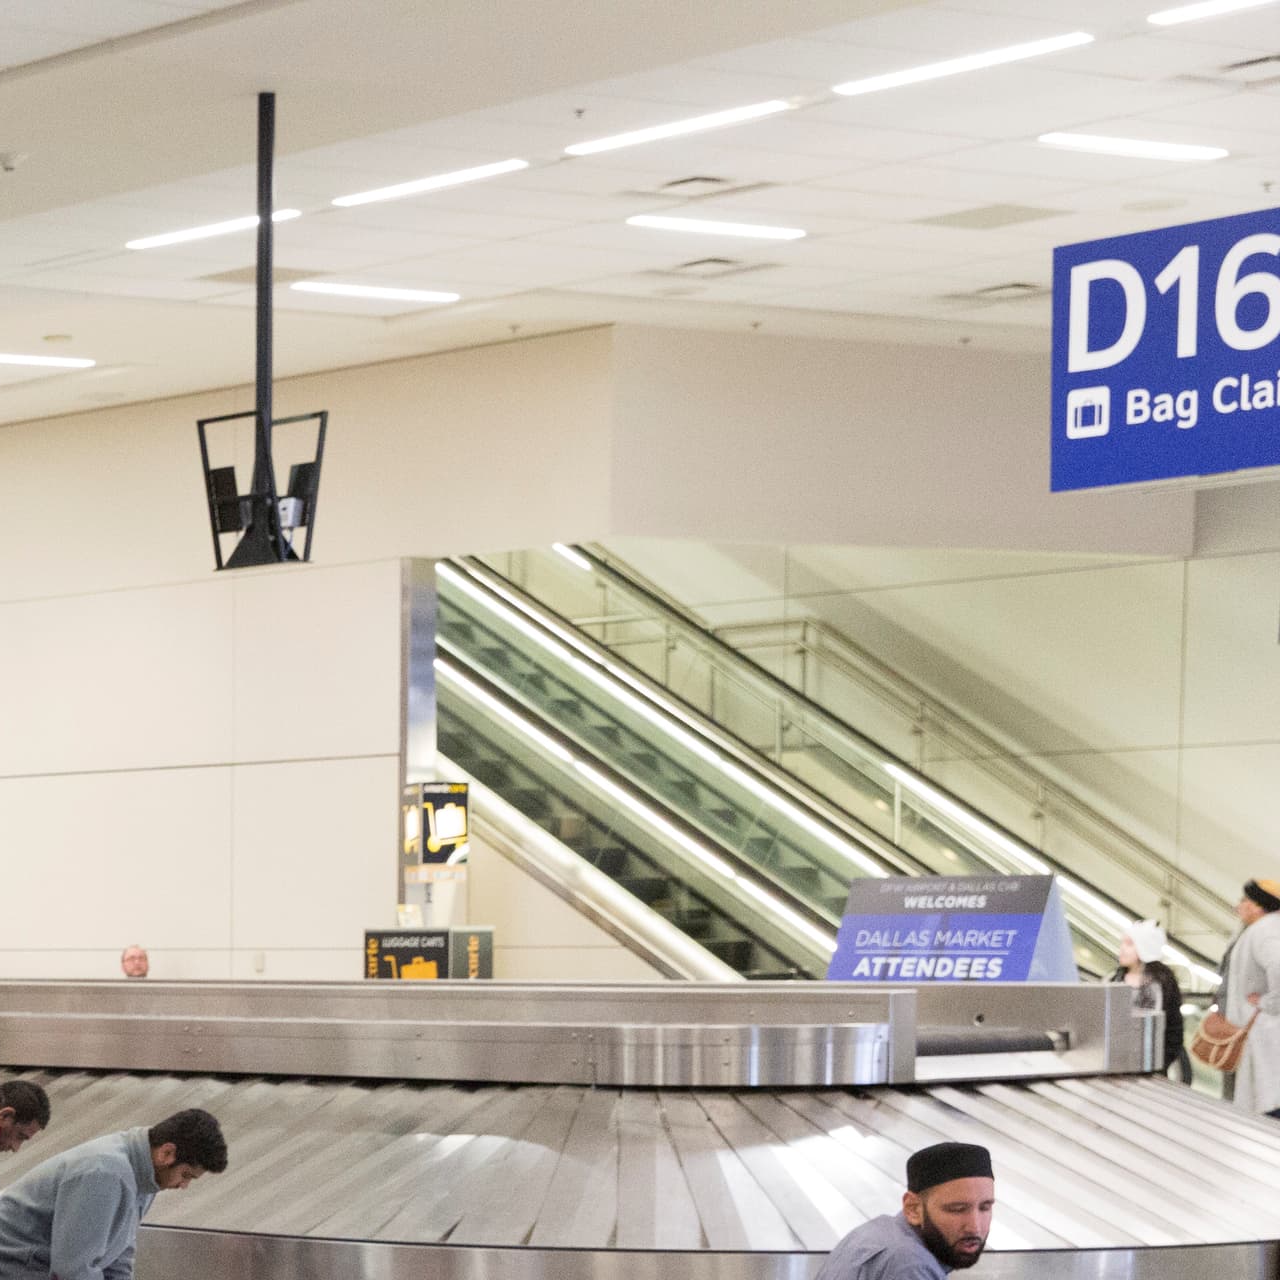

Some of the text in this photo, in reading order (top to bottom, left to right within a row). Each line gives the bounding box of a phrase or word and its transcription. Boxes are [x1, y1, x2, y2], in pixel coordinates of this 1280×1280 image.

[1068, 233, 1280, 373] D16
[1126, 389, 1198, 429] Bag
[904, 895, 987, 909] WELCOMES
[382, 936, 444, 948] LUGGAGE CARTS
[855, 930, 1017, 947] DALLAS MARKET
[853, 957, 1003, 978] ATTENDEES
